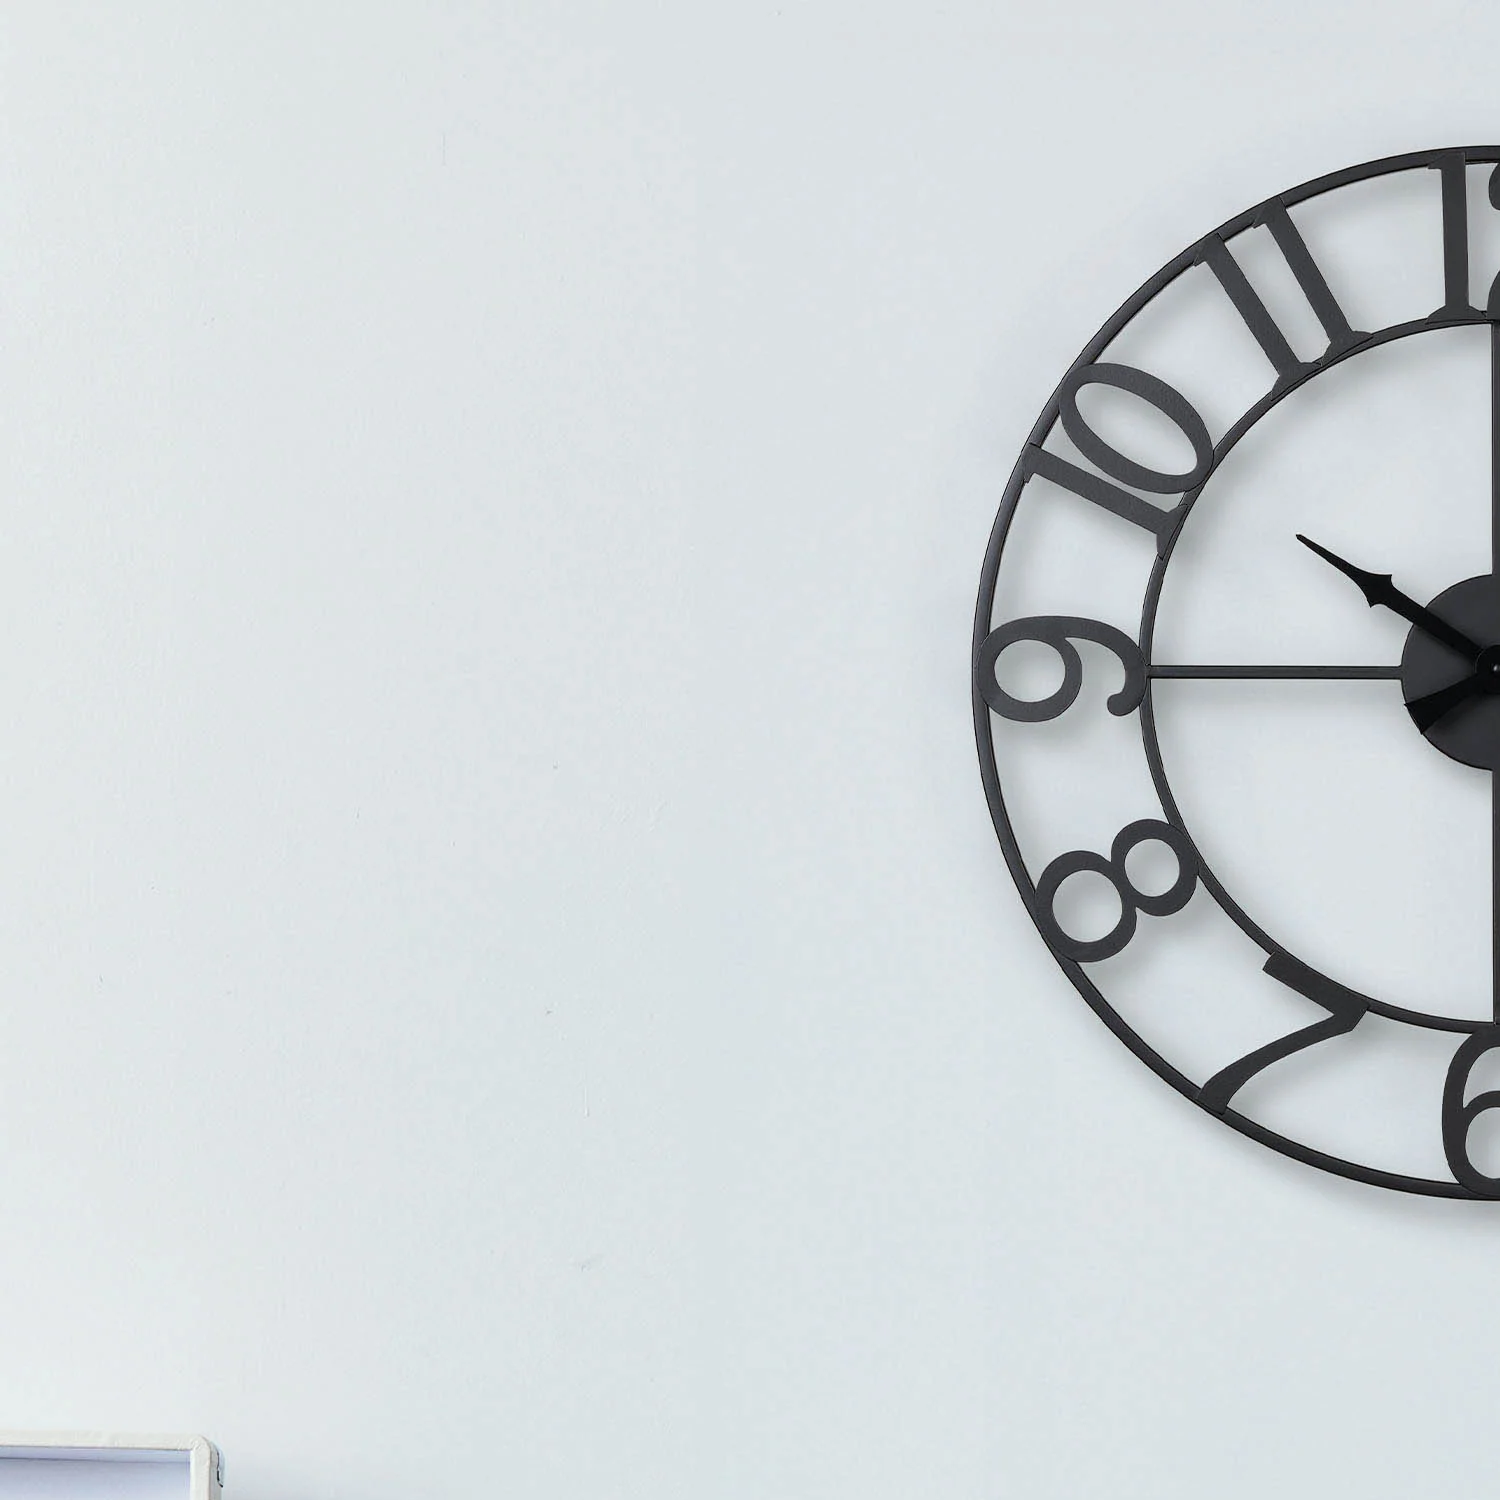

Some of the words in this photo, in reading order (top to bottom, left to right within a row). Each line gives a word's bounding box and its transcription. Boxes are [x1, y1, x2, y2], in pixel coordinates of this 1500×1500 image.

[1194, 195, 1373, 401] 11
[1022, 362, 1214, 560] 10
[977, 616, 1147, 722] 9
[1036, 819, 1198, 962] 8
[1198, 951, 1371, 1115] 7
